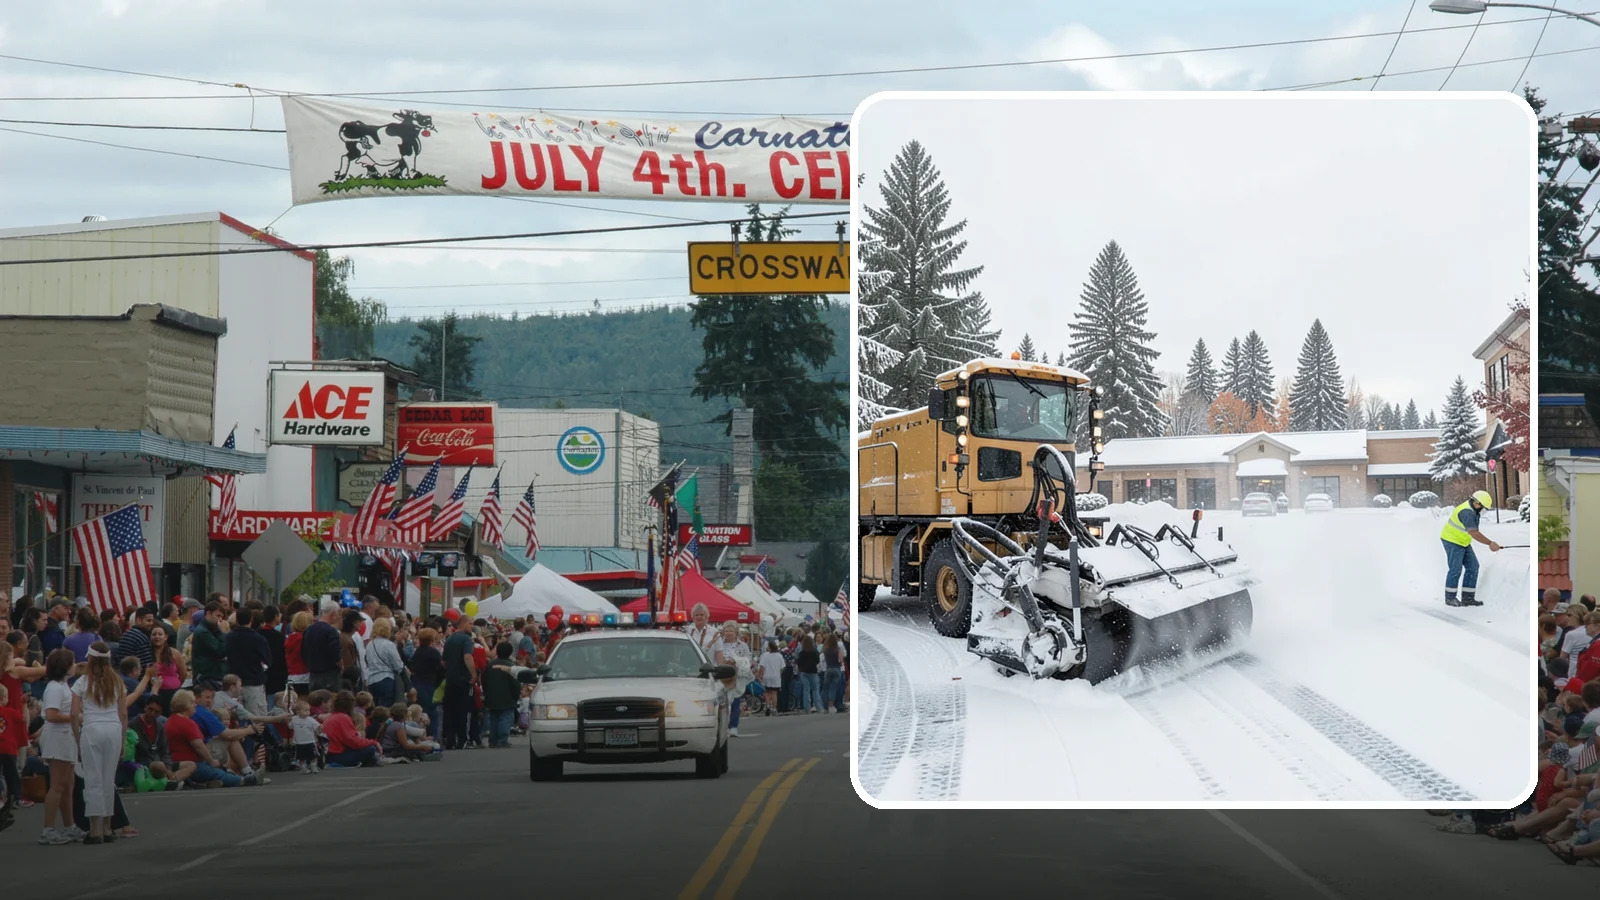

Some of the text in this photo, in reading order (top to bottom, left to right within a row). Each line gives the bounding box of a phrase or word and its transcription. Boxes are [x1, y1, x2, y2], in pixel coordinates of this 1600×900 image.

[481, 140, 605, 192] JULY
[632, 150, 747, 198] 4th.
[697, 254, 850, 280] CROSSWA
[282, 380, 374, 420] ACE
[405, 409, 453, 422] CEDAR
[283, 421, 371, 436] Hardware
[416, 428, 477, 447] Coca-Cola
[353, 467, 385, 480] Simpl
[96, 485, 124, 495] Vincent
[126, 486, 136, 495] de
[137, 486, 155, 495] Paul
[688, 526, 741, 535] CRNATION
[699, 535, 730, 543] GLASS
